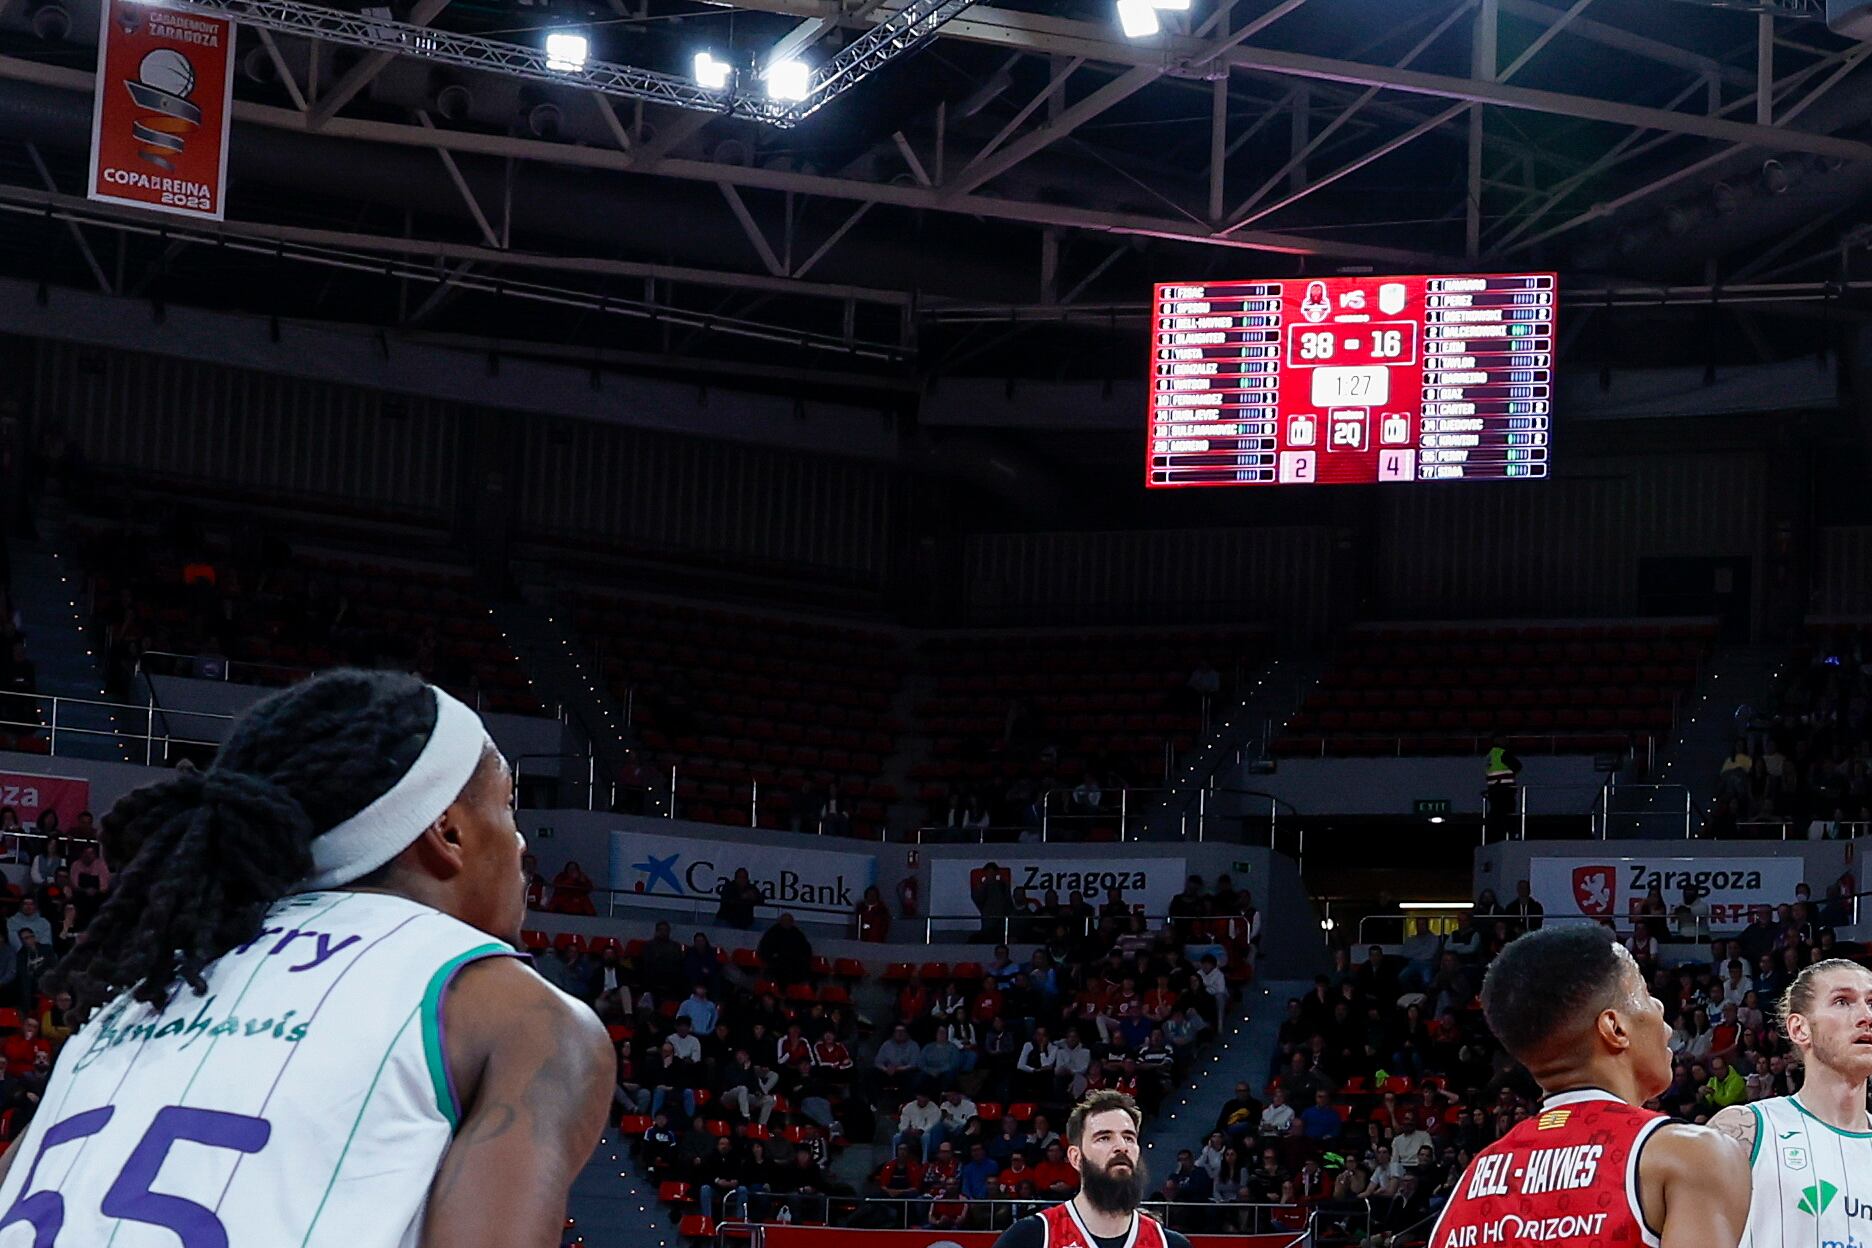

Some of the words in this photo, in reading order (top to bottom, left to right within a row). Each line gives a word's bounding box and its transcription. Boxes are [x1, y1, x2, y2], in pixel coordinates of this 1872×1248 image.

[104, 168, 149, 189] COPA
[162, 180, 210, 198] REINA
[162, 193, 210, 210] 2023
[1339, 290, 1366, 309] VS
[1300, 332, 1334, 359] 38
[1371, 330, 1401, 358] 16
[1337, 375, 1372, 395] 1:27
[1334, 422, 1361, 447] 2Q
[1295, 458, 1307, 478] 2
[1387, 456, 1399, 476] 4
[686, 860, 853, 907] CaaBank
[1023, 866, 1146, 898] Zaragoza
[1630, 866, 1761, 898] Zaragoza
[1483, 1213, 1608, 1245] HORIZONT
